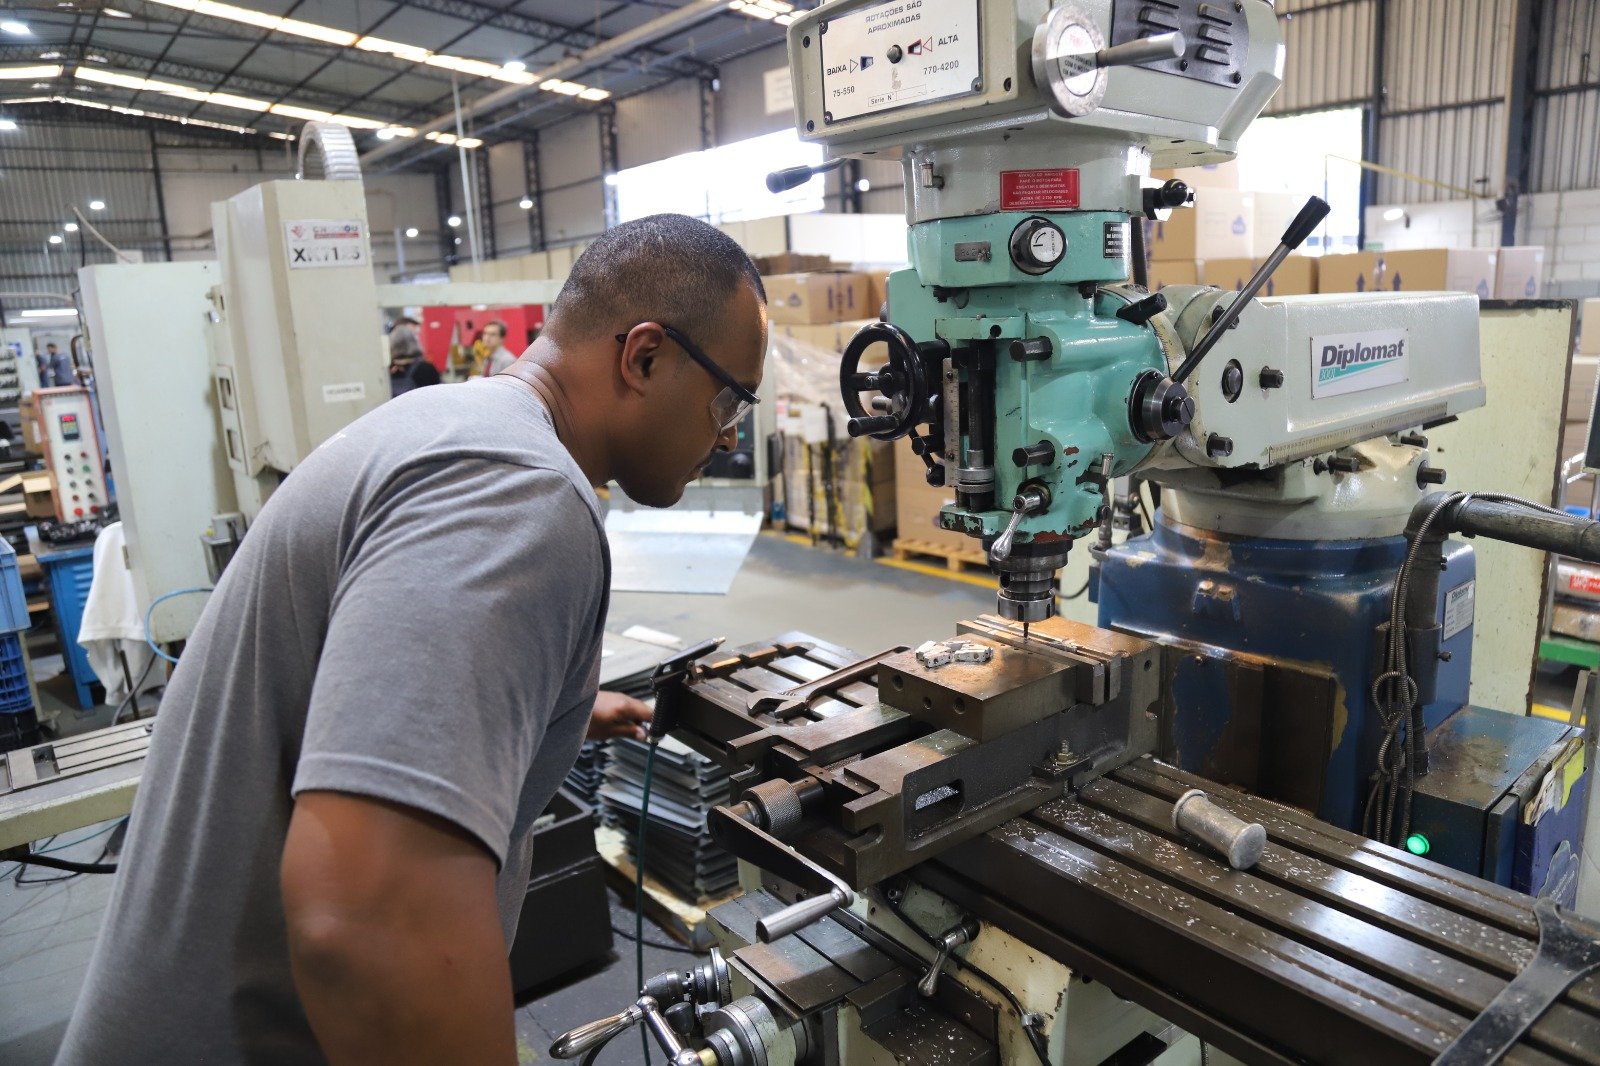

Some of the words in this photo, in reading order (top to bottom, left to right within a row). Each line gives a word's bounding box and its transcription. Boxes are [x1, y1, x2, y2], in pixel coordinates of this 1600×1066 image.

[867, 13, 921, 35] APROXIMADAS
[938, 34, 959, 46] ALTA
[827, 64, 847, 76] BAIXA
[923, 60, 960, 75] 770-4200
[833, 85, 855, 98] 75-550
[1321, 339, 1405, 370] Diplomat
